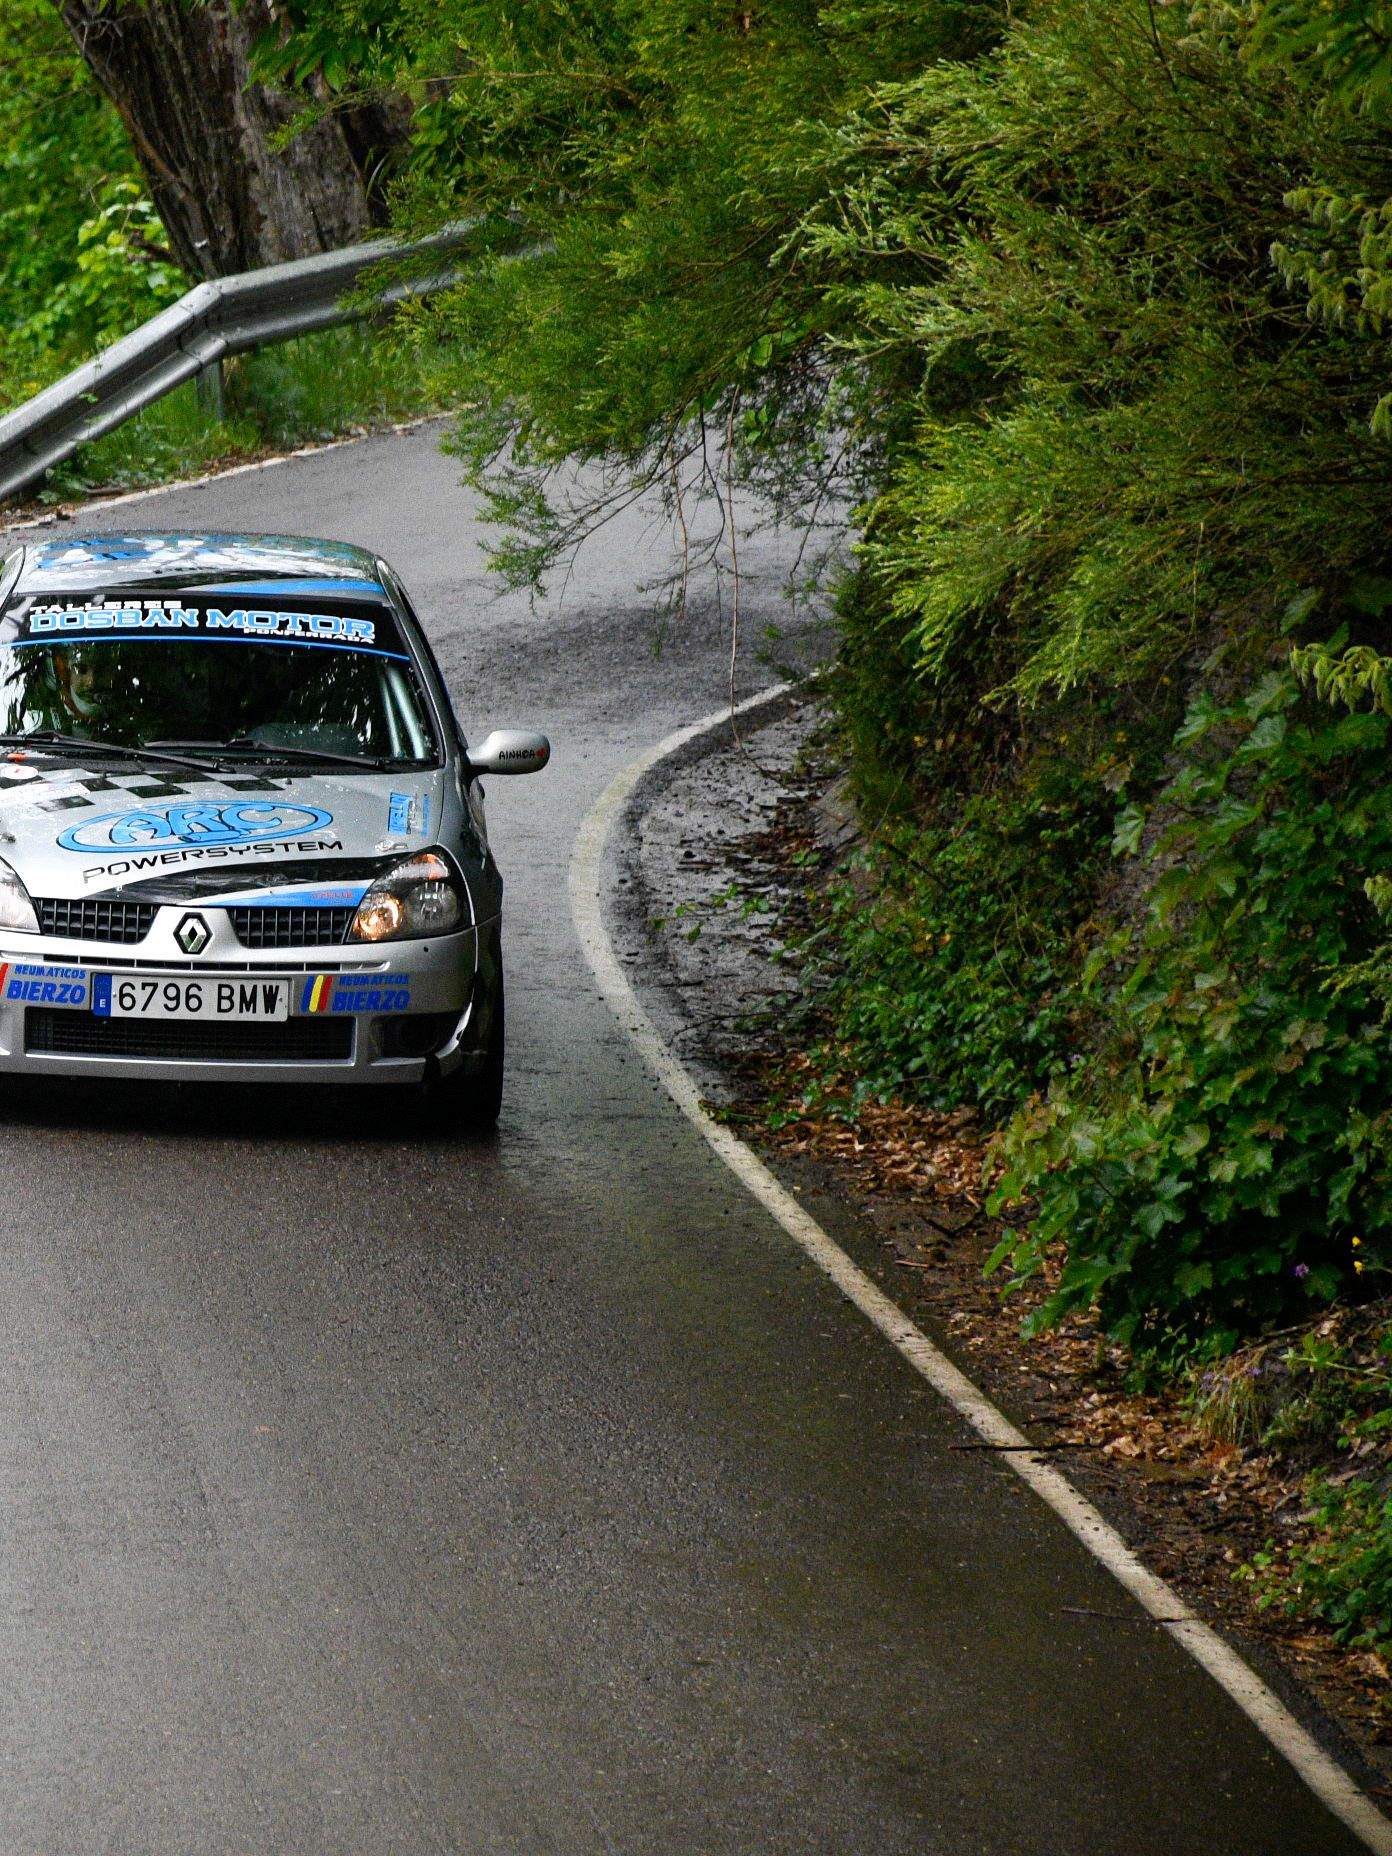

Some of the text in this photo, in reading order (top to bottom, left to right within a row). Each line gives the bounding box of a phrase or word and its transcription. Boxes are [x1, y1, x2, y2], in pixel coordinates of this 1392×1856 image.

[29, 600, 182, 614] TALLERES
[29, 608, 376, 640] DOSBAN MOTOR
[108, 803, 283, 845] ARC
[82, 840, 344, 884] POWERSYSTEM
[7, 979, 87, 1005] BIERZO
[118, 981, 280, 1015] 6796 BMW
[331, 988, 411, 1012] BIERZO
